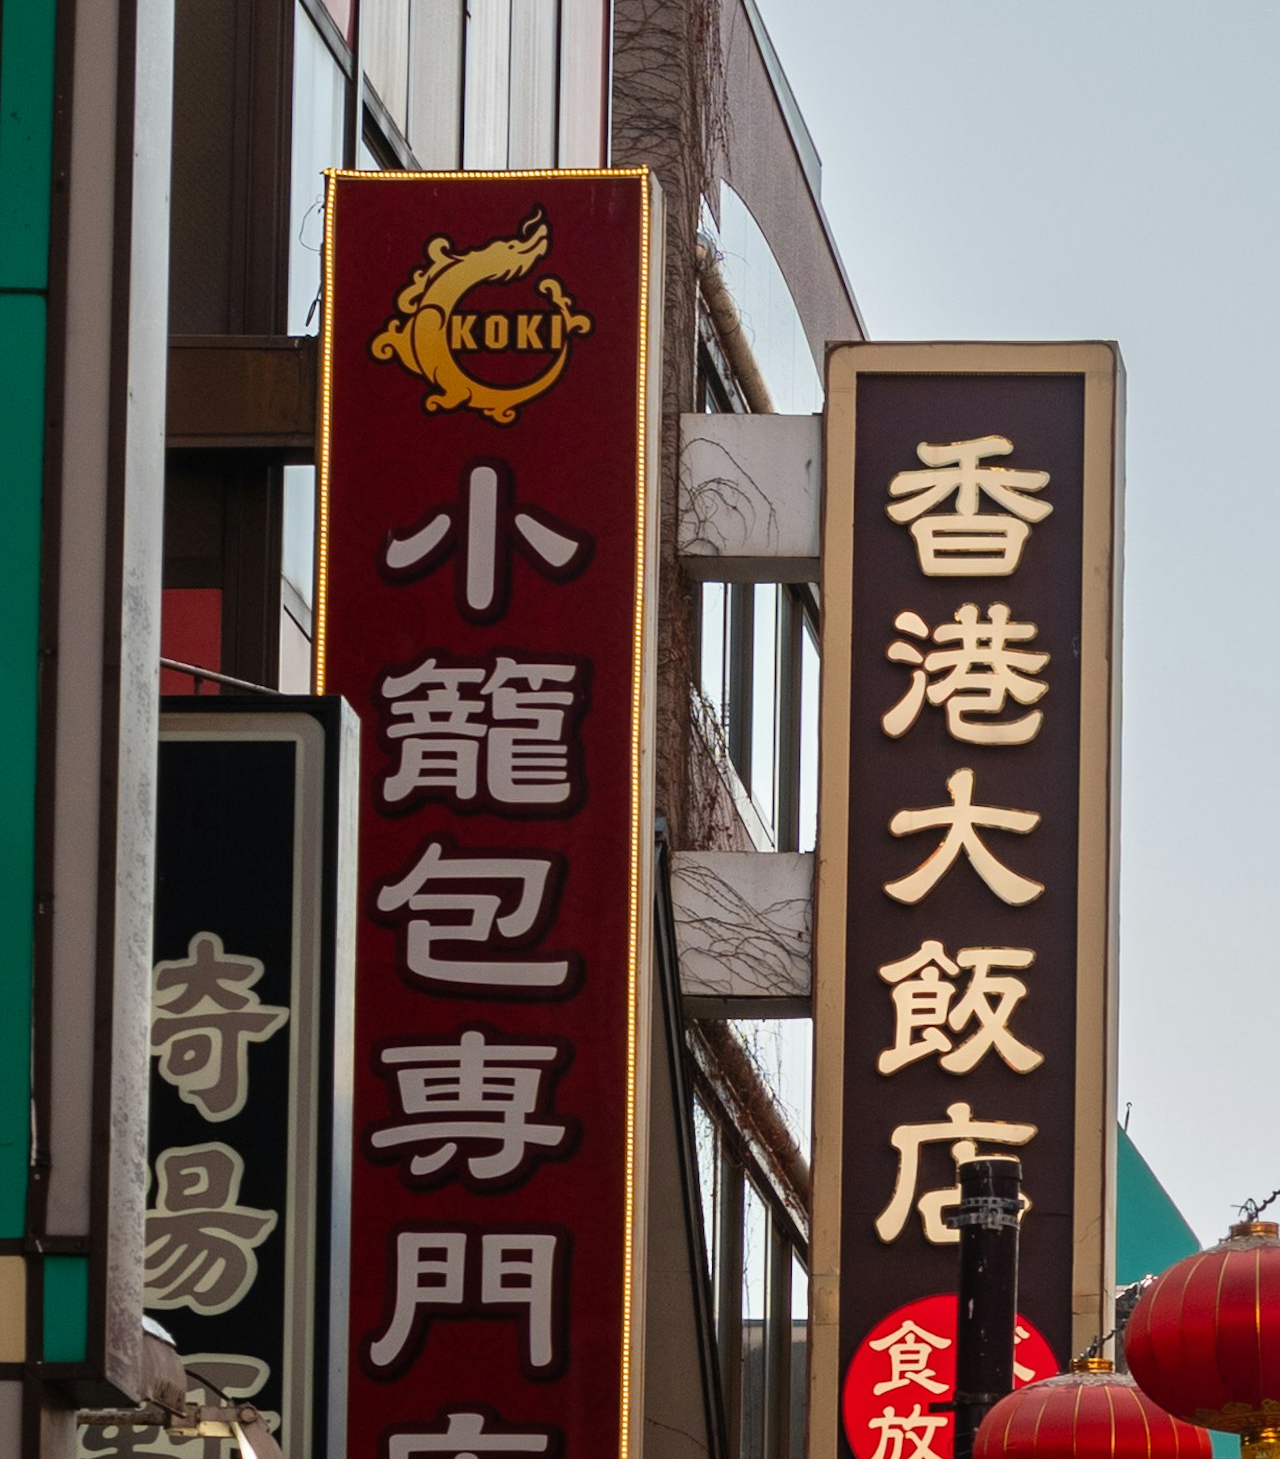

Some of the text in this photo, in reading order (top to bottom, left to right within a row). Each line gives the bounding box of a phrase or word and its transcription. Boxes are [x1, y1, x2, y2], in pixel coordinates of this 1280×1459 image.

[450, 313, 562, 351] KOKI
[874, 434, 1054, 1245] 香港大飯店
